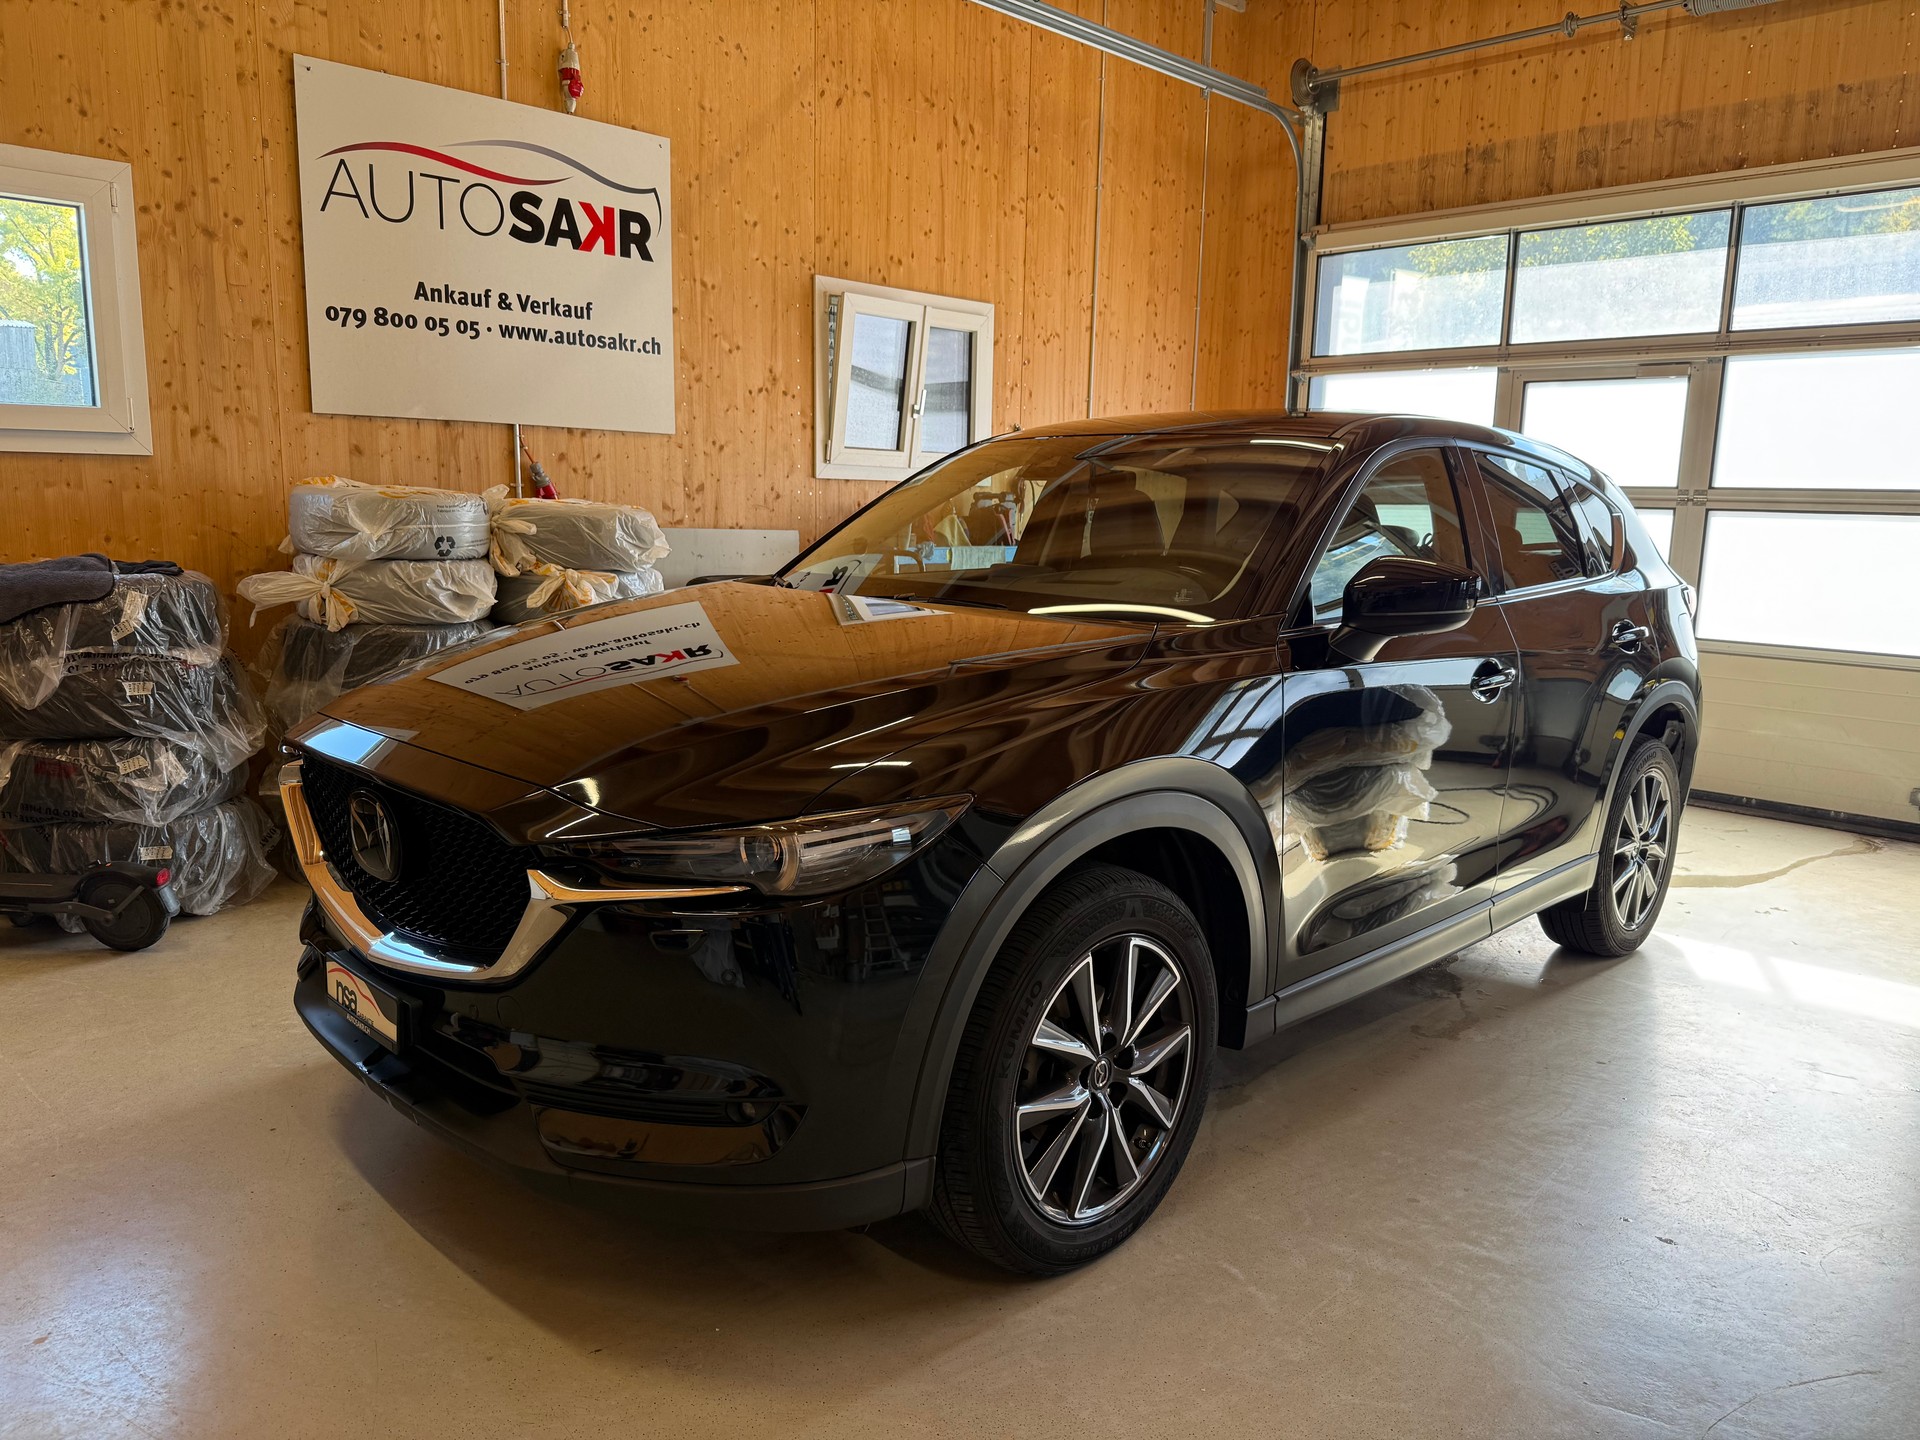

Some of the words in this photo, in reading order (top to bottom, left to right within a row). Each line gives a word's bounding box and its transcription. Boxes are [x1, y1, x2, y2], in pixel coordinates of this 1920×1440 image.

[320, 158, 654, 262] AUTOSAKR
[325, 305, 367, 329] 079
[373, 306, 418, 331] 800
[424, 316, 450, 337] 05
[456, 319, 481, 341] 05
[498, 321, 662, 356] www.autosakr.ch
[414, 281, 492, 309] Ankauf
[497, 291, 513, 312] &
[517, 293, 593, 321] Verkauf
[998, 979, 1044, 1079] KUMHO
